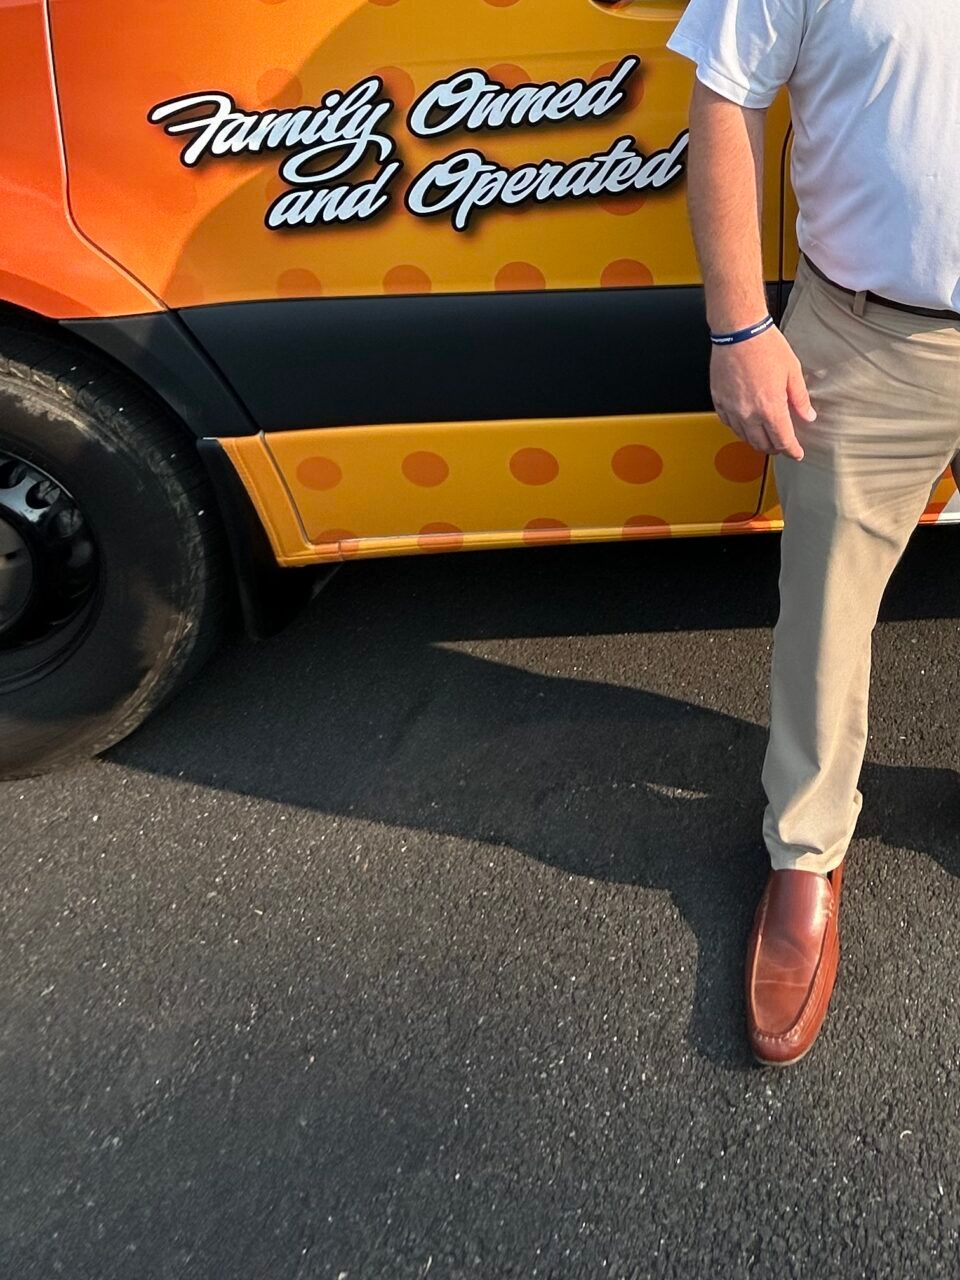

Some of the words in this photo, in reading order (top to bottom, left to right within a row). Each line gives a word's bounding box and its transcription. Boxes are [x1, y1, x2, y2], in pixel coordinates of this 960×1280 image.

[149, 78, 393, 184] Family
[408, 57, 637, 136] Owned
[266, 161, 400, 228] and
[406, 131, 689, 229] Operated
